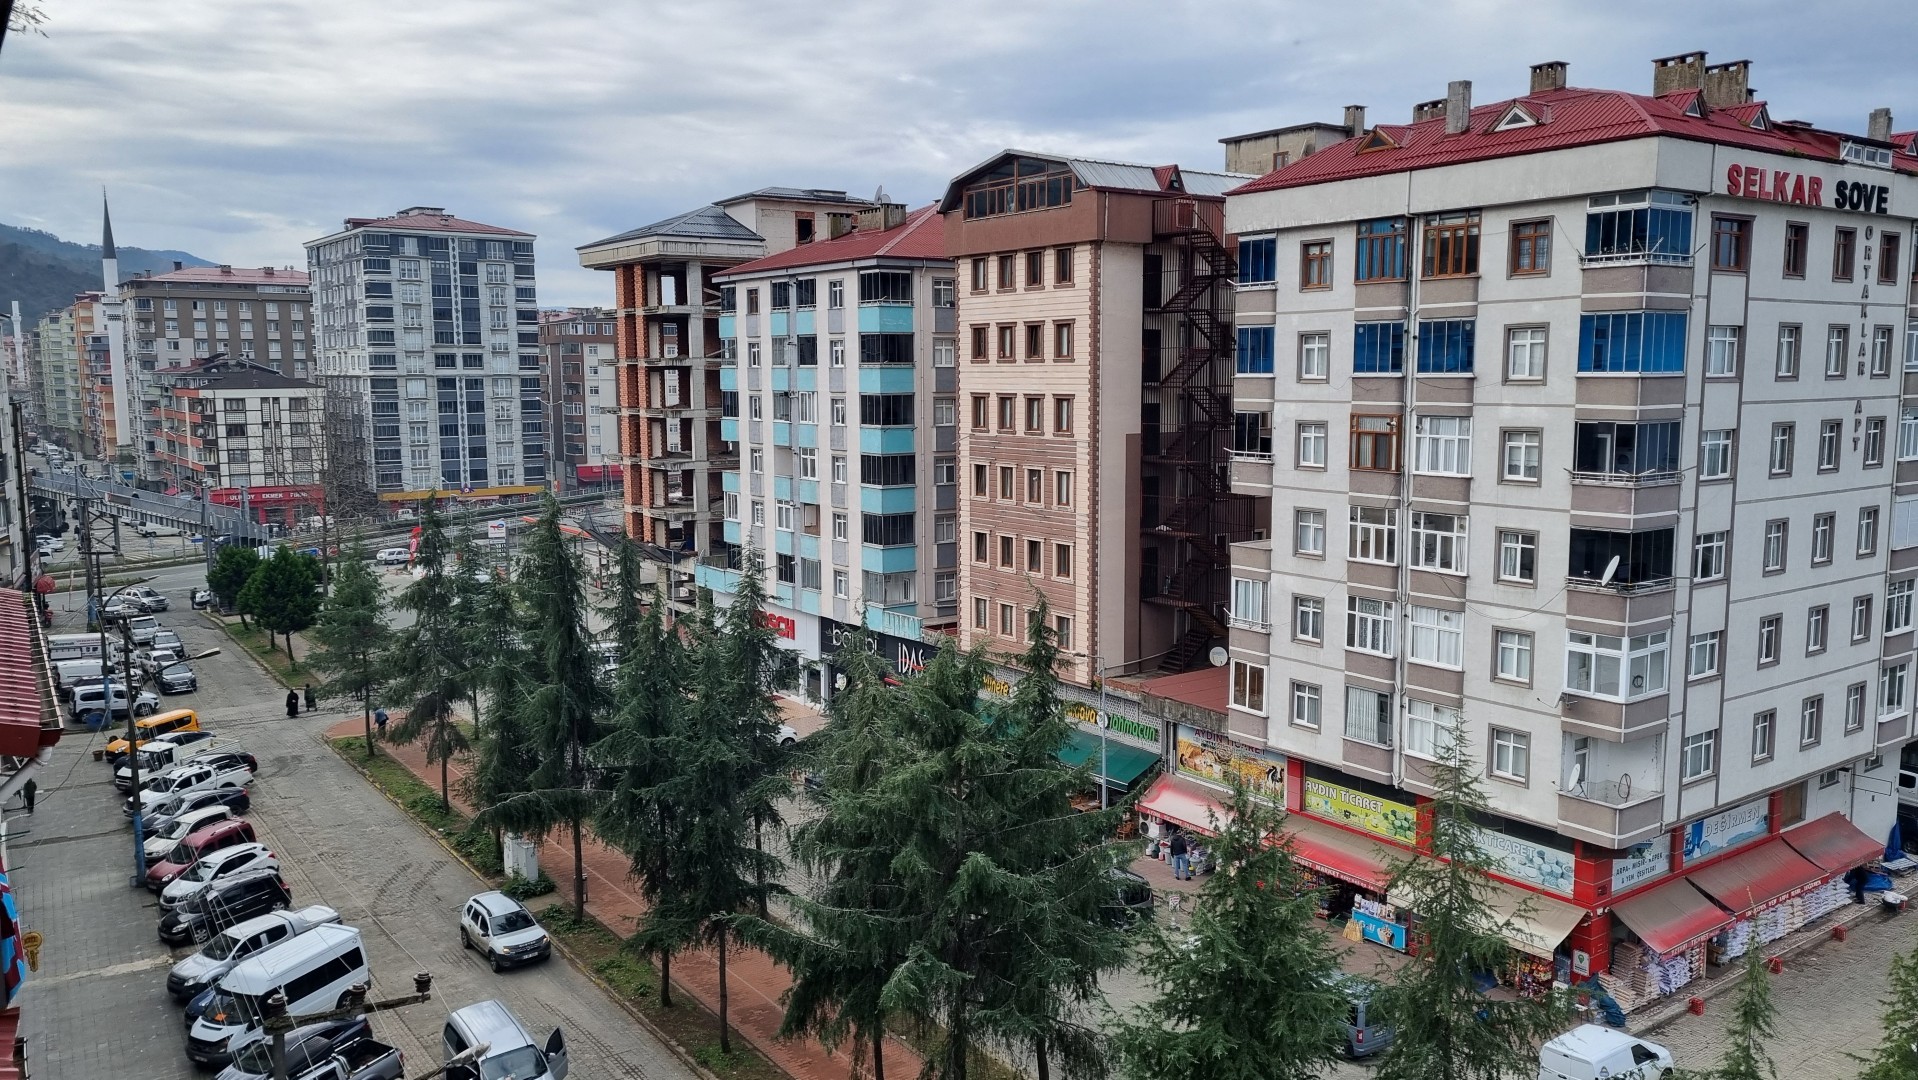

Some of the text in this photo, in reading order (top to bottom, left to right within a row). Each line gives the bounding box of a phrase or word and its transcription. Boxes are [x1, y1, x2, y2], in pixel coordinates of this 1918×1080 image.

[1727, 163, 1890, 214] SELKAR SOVE
[1852, 225, 1874, 453] ORTAKLAR APT
[1305, 780, 1384, 814] AYDIN TİCARET
[1705, 805, 1761, 838] DEĞİRMEN
[1486, 831, 1536, 859] TİCARET
